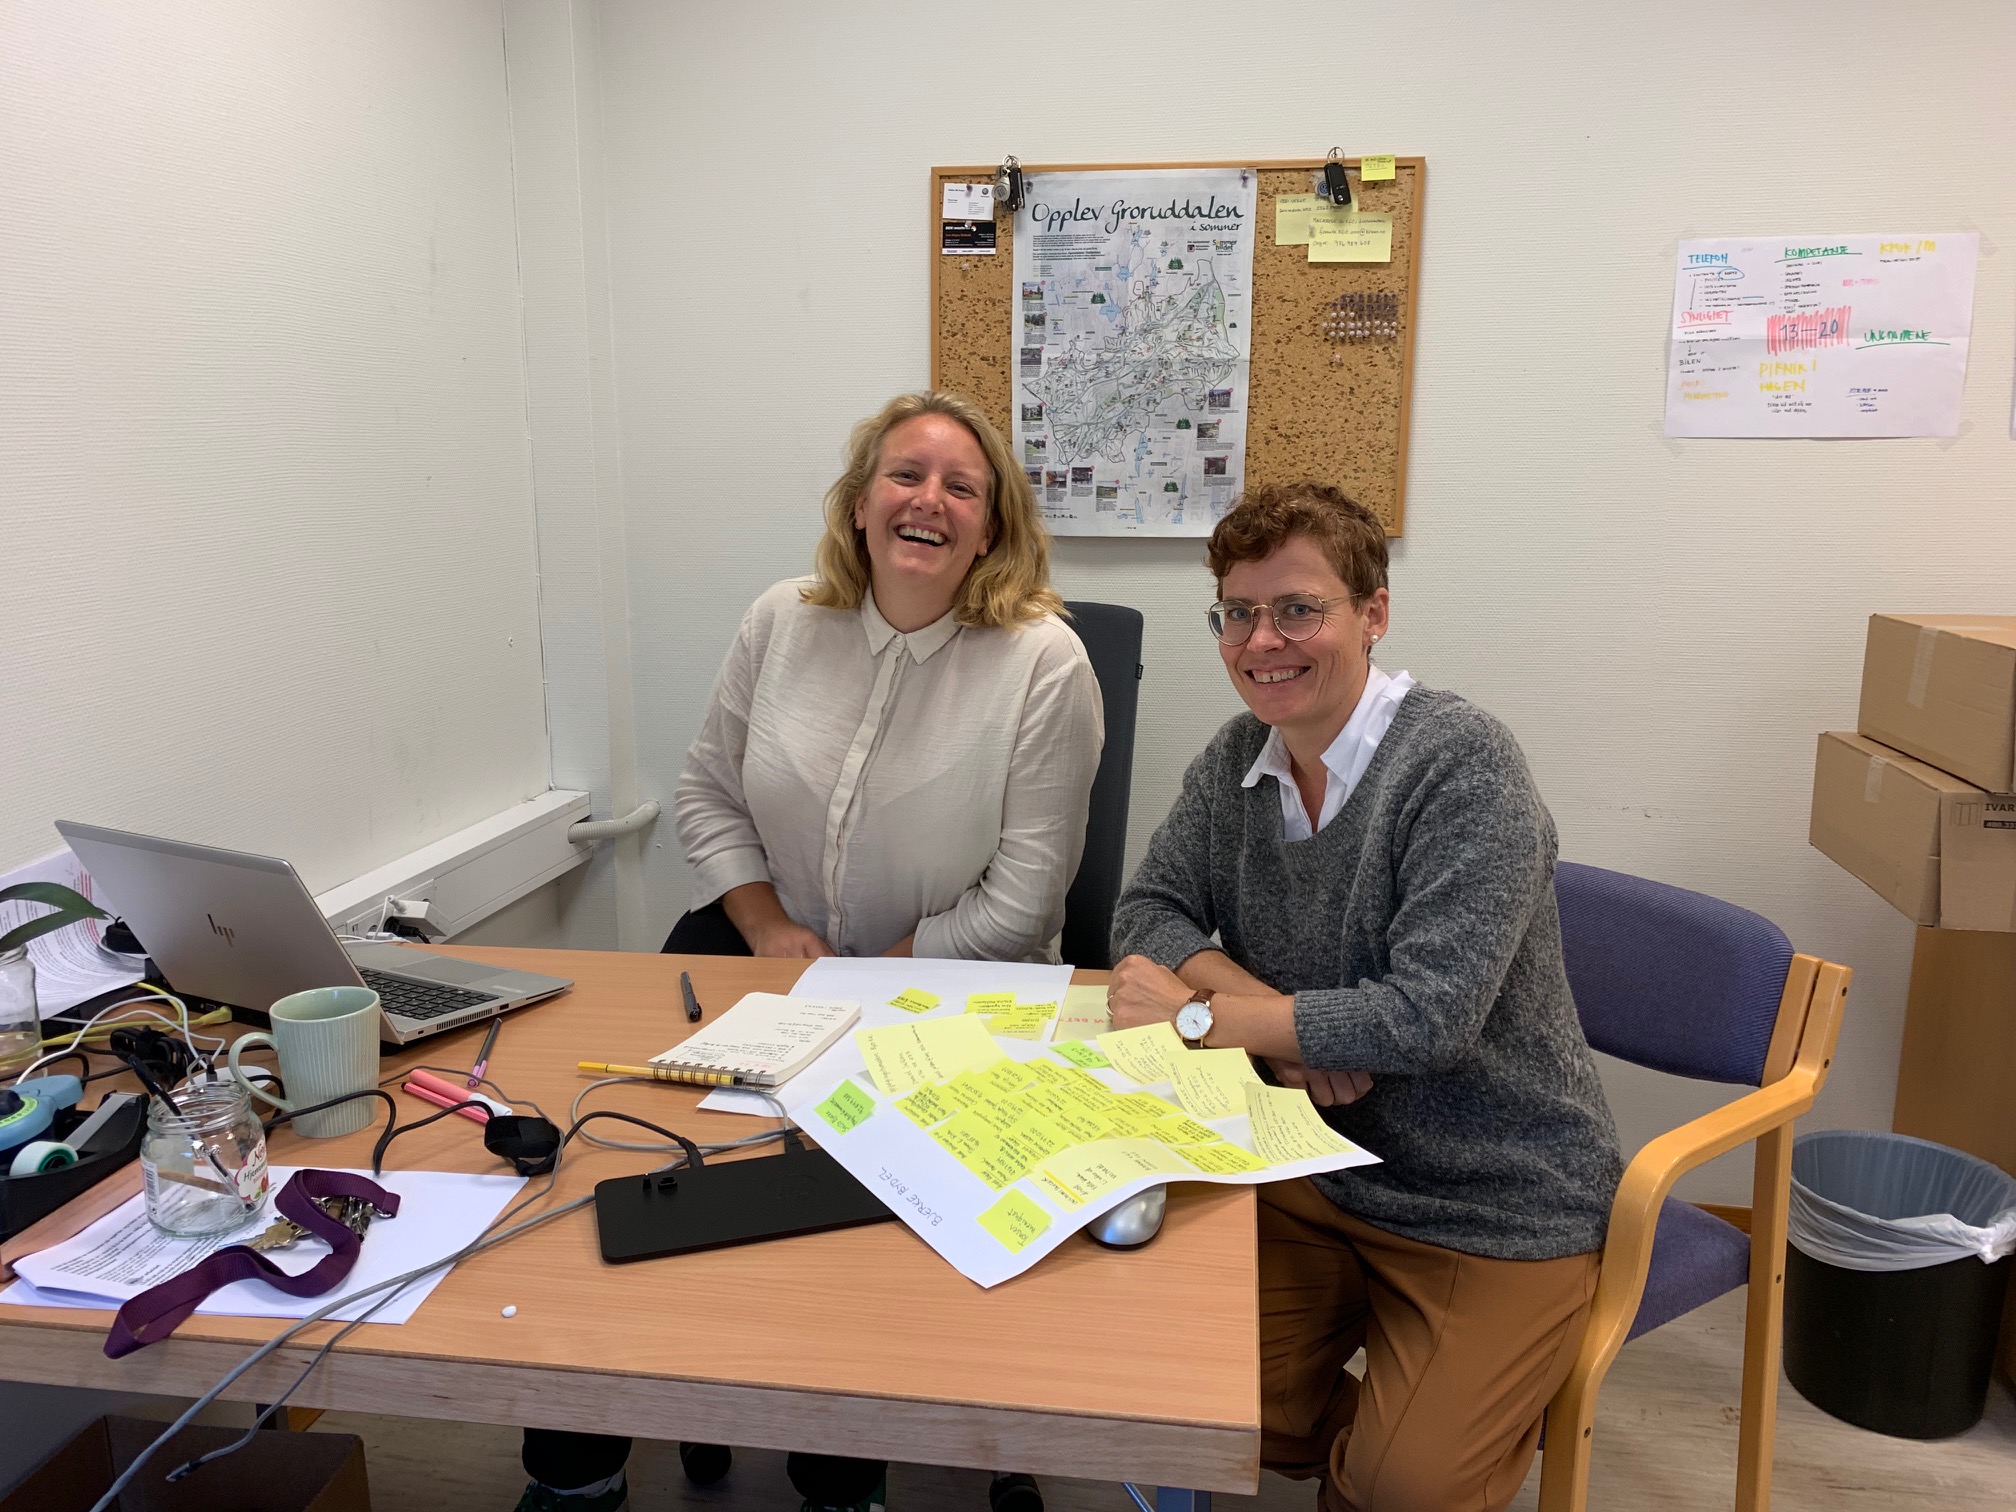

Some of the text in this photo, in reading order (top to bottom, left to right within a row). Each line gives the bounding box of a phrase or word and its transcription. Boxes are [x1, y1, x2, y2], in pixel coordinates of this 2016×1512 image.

[1032, 196, 1245, 234] Opplev Groruddalen
[1190, 221, 1242, 232] i sommer
[1985, 803, 2015, 812] IVAR
[207, 913, 236, 948] hp
[878, 1166, 943, 1227] BJERKE BYDEL
